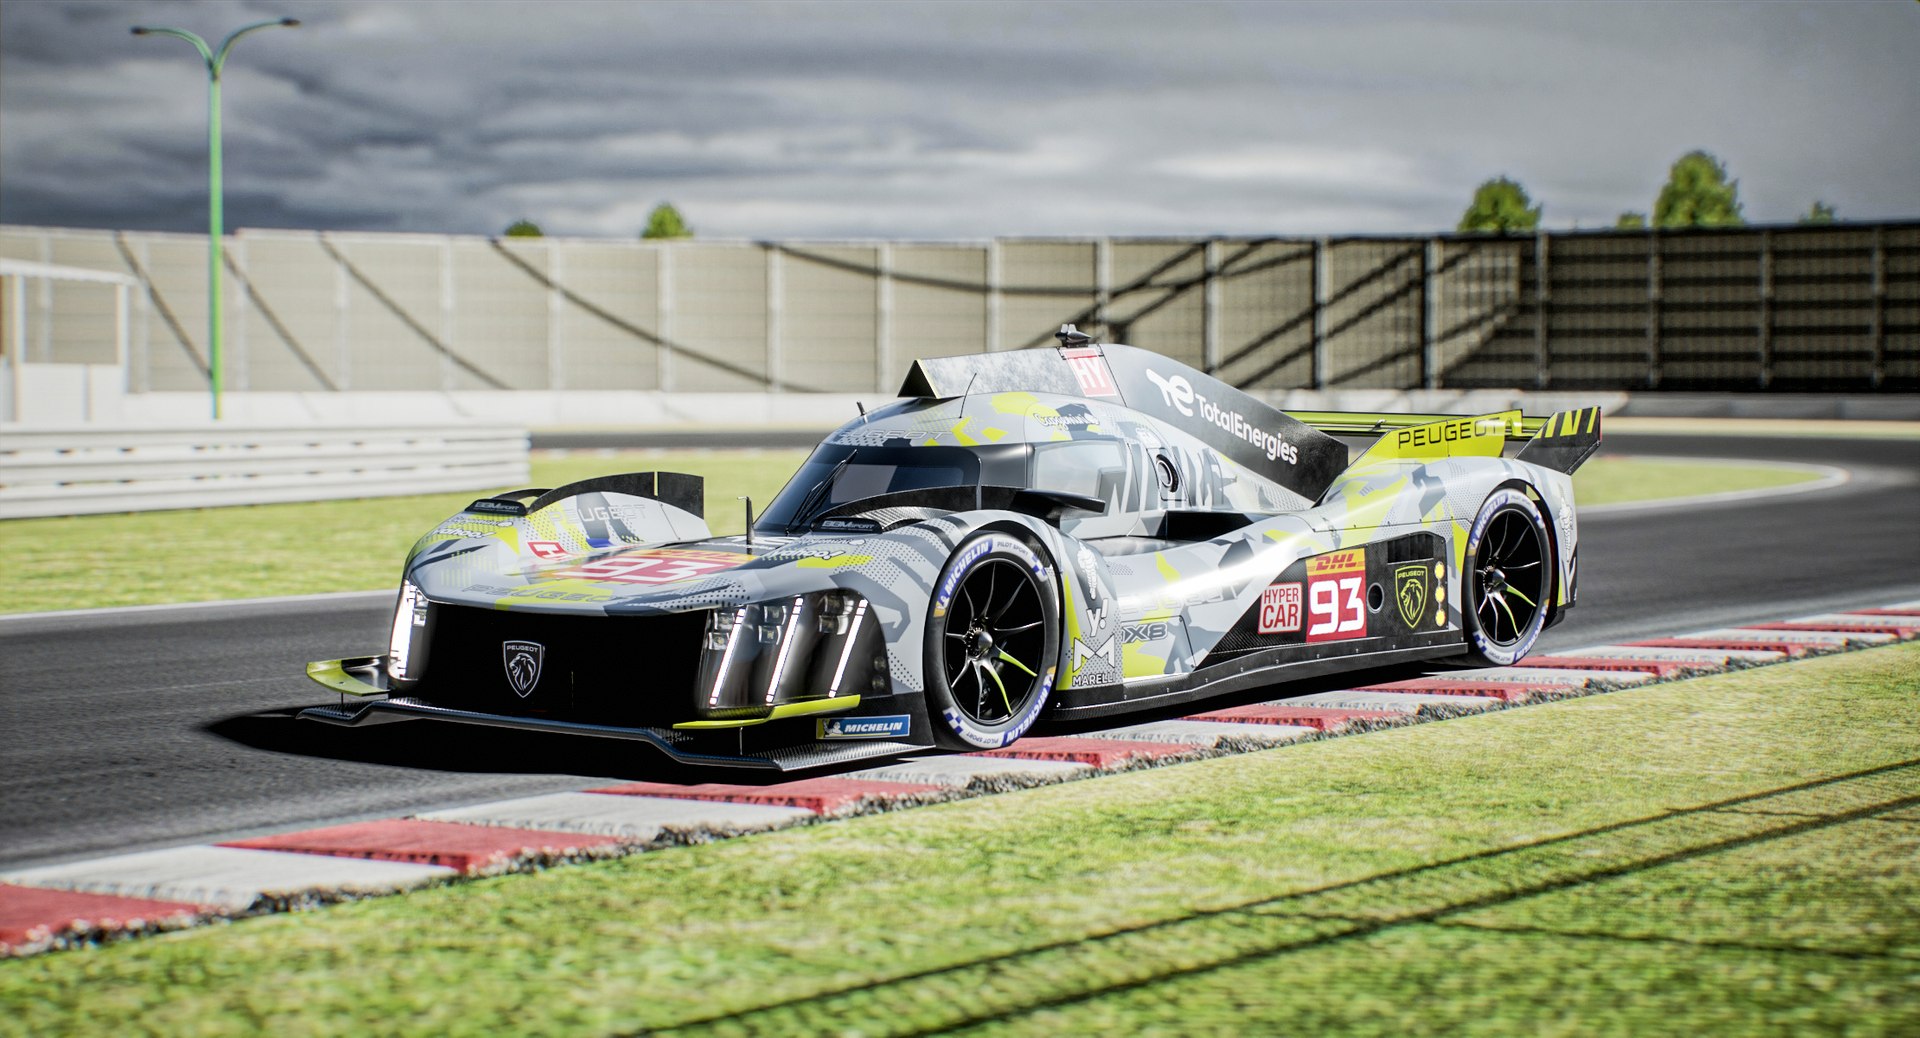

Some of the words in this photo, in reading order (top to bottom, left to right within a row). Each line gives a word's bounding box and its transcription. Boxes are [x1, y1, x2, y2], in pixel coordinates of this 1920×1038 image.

[1069, 357, 1108, 389] HY
[1194, 393, 1299, 465] TotalEnergies
[1398, 417, 1501, 450] PEUGEOT
[552, 557, 727, 583] 93
[944, 541, 990, 598] MICHELIN
[1315, 553, 1358, 571] DHL
[1397, 570, 1425, 579] PEUGEOT
[1264, 587, 1299, 604] HYPER
[1308, 576, 1365, 636] 93
[1262, 604, 1298, 630] CAR
[506, 645, 539, 653] PEUGEOT
[1072, 672, 1116, 687] MARELLI
[844, 721, 903, 733] MICHELIN
